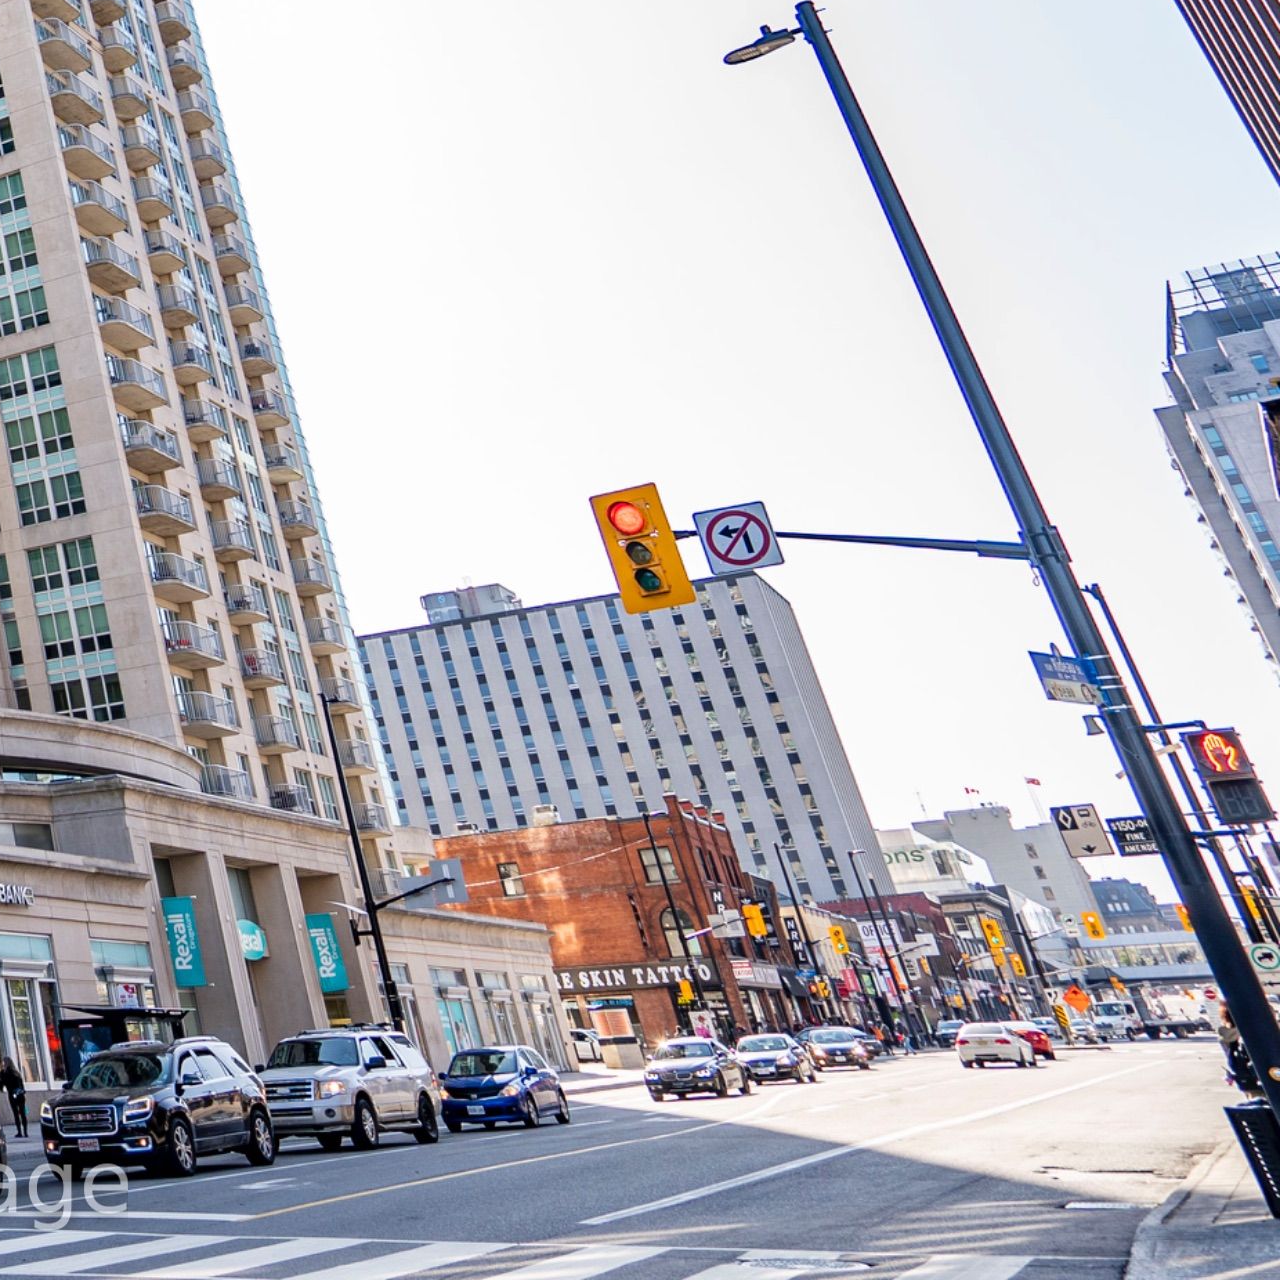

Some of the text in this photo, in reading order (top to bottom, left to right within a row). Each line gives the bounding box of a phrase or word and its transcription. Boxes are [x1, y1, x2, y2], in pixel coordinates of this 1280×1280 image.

[1125, 831, 1146, 842] FINE
[1124, 842, 1159, 853] AMENDE
[168, 913, 193, 970] Rexall
[310, 928, 336, 977] Rexall
[578, 969, 627, 988] SKIN
